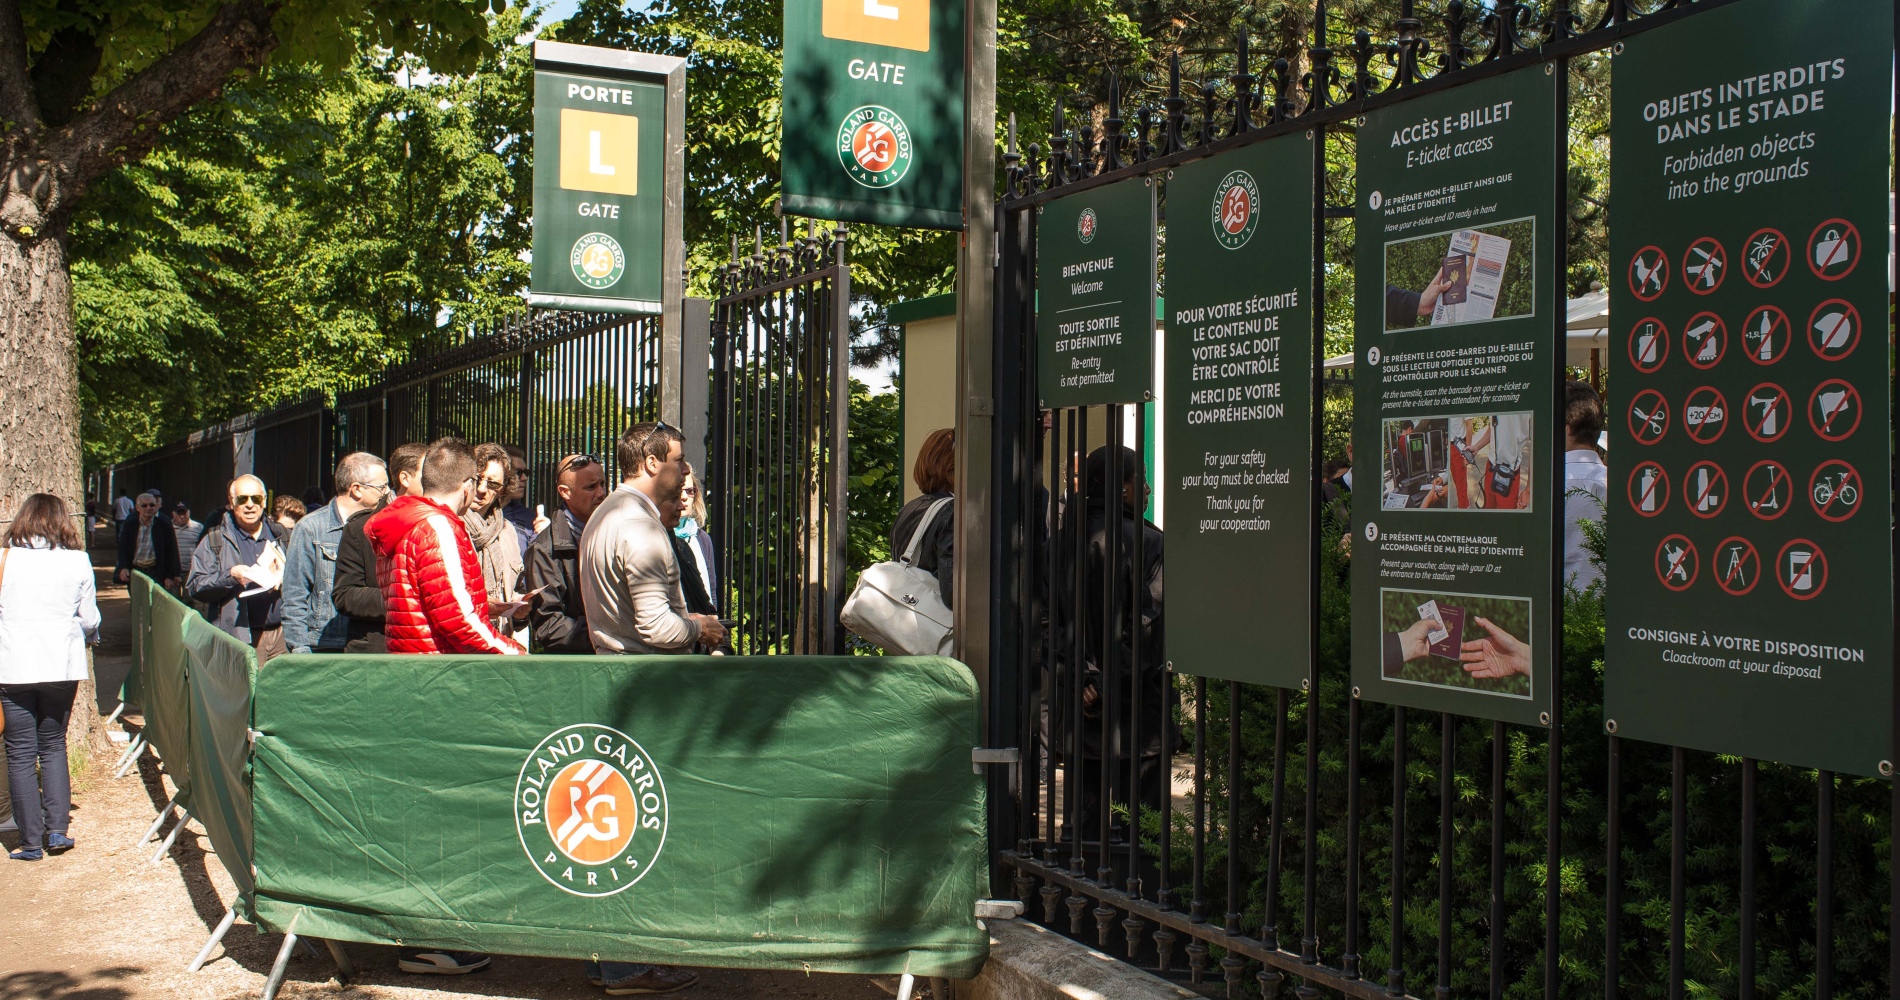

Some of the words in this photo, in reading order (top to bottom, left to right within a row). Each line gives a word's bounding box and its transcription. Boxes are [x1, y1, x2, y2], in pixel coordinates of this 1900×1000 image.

[847, 59, 906, 85] GATE
[568, 83, 633, 105] PORTE
[1643, 87, 1712, 122] OBJETS
[1719, 58, 1845, 104] INTERDITS
[1390, 118, 1439, 148] ACCÈS
[1444, 101, 1512, 134] E-BILLET
[1657, 114, 1710, 144] DANS
[1718, 106, 1741, 130] LE
[1748, 89, 1824, 124] STADE
[841, 109, 874, 152] ROLAND
[878, 111, 908, 159] GARROS
[589, 130, 616, 175] L
[1406, 142, 1451, 168] E-ticket
[1454, 136, 1494, 158] access
[1664, 144, 1744, 176] Forbidden
[1750, 130, 1816, 160] objects
[852, 165, 897, 183] PARIS
[1668, 180, 1698, 200] into
[1704, 172, 1729, 193] the
[1734, 156, 1809, 194] grounds
[1214, 176, 1234, 223] ROLAND
[1236, 174, 1258, 214] GARROS
[1384, 198, 1392, 206] JE
[1392, 190, 1422, 204] PRÉPARE
[1424, 188, 1440, 198] MON
[1442, 182, 1473, 194] E-BILLET
[1474, 176, 1494, 188] AINSI
[1496, 172, 1512, 182] QUE
[578, 202, 620, 219] GATE
[1384, 208, 1395, 216] MA
[1396, 202, 1416, 214] PIÈCE
[1418, 193, 1456, 210] D'IDENTITÉ
[1384, 224, 1398, 232] Have
[1398, 222, 1413, 232] your
[1412, 216, 1434, 227] e-ticket
[1434, 213, 1446, 222] and
[1446, 212, 1455, 220] ID
[1455, 208, 1472, 219] ready
[1480, 203, 1498, 214] hand
[1220, 226, 1250, 244] PARIS
[574, 235, 598, 265] ROLAND
[600, 236, 622, 268] GARROS
[1062, 257, 1114, 278] BIENVENUE
[1071, 281, 1103, 296] Welcome
[1176, 308, 1204, 325] POUR
[1207, 301, 1242, 320] VOTRE
[1245, 288, 1298, 314] SÉCURITÉ
[1059, 321, 1084, 336] TOUTE
[1086, 316, 1120, 332] SORTIE
[1194, 327, 1205, 342] LE
[1208, 318, 1261, 340] CONTENU
[1264, 316, 1278, 332] DE
[1056, 340, 1069, 352] EST
[1070, 332, 1122, 350] DÉFINITIVE
[1192, 344, 1226, 361] VOTRE
[1230, 340, 1250, 356] SAC
[1254, 336, 1280, 354] DOIT
[1392, 352, 1424, 362] PRÉSENTE
[1426, 352, 1434, 360] LE
[1436, 346, 1486, 358] CODE-BARRES
[1488, 345, 1498, 353] DU
[1500, 342, 1534, 352] E-BILLET
[1071, 356, 1101, 370] Re-entry
[1192, 363, 1218, 381] ÊTRE
[1220, 354, 1280, 378] CONTRÔLÉ
[1382, 364, 1400, 373] SOUS
[1400, 364, 1408, 372] LE
[1410, 361, 1440, 370] LECTEUR
[1441, 358, 1472, 368] OPTIQUE
[1474, 357, 1485, 365] DU
[1486, 354, 1520, 364] TRIPODE
[1522, 352, 1534, 360] OU
[1060, 374, 1066, 387] is
[1066, 374, 1078, 386] not
[1078, 369, 1115, 388] permitted
[1393, 371, 1438, 382] CONTRÔLEUR
[1440, 370, 1460, 378] POUR
[1460, 368, 1469, 376] LE
[1470, 366, 1506, 376] SCANNER
[1190, 388, 1224, 405] MERCI
[1228, 386, 1242, 402] DE
[1244, 382, 1280, 400] VOTRE
[1382, 391, 1390, 399] At
[1390, 390, 1399, 398] the
[1438, 386, 1447, 394] the
[1448, 384, 1472, 394] barcode
[1482, 384, 1497, 394] your
[1498, 382, 1522, 392] e-ticket
[1382, 402, 1402, 410] present
[1402, 399, 1412, 408] the
[1412, 398, 1433, 407] e-ticket
[1440, 396, 1450, 405] the
[1452, 394, 1482, 404] attendant
[1481, 394, 1492, 404] for
[1492, 392, 1520, 402] scanning
[1187, 403, 1284, 424] COMPRÉHENSION
[1204, 452, 1218, 466] For
[1220, 454, 1240, 469] your
[1240, 448, 1266, 468] safety
[1182, 475, 1201, 490] your
[1203, 472, 1220, 489] bag
[1221, 472, 1242, 486] must
[1244, 470, 1254, 485] be
[1256, 468, 1290, 484] checked
[1206, 495, 1232, 510] Thank
[1234, 498, 1250, 514] you
[1252, 494, 1264, 513] for
[1200, 518, 1219, 534] your
[1220, 516, 1270, 534] cooperation
[1380, 542, 1432, 552] ACCOMPAGNÉE
[1458, 544, 1479, 554] PIÈCE
[1480, 546, 1524, 556] D'IDENTITÉ
[1389, 532, 1422, 542] PRÉSENTE
[1424, 534, 1436, 542] MA
[1436, 535, 1498, 544] CONTREMARQUE
[1380, 558, 1400, 568] Present
[1400, 561, 1414, 570] your
[1414, 560, 1436, 570] voucher,
[1438, 562, 1456, 572] along
[1456, 563, 1470, 572] with
[1470, 564, 1484, 574] your
[1380, 568, 1390, 577] the
[1390, 570, 1414, 578] entrance
[1422, 570, 1432, 579] the
[1432, 572, 1456, 580] stadium
[1628, 627, 1697, 646] CONSIGNE
[1700, 631, 1710, 647] À
[1713, 635, 1760, 652] VOTRE
[1764, 640, 1864, 662] DISPOSITION
[1662, 650, 1726, 668] Cloackroom
[1728, 658, 1740, 670] at
[1743, 662, 1770, 674] your
[1772, 662, 1822, 680] disposal
[522, 733, 584, 826] ROLAND
[594, 734, 660, 830] GARROS
[544, 851, 638, 886] PARIS
